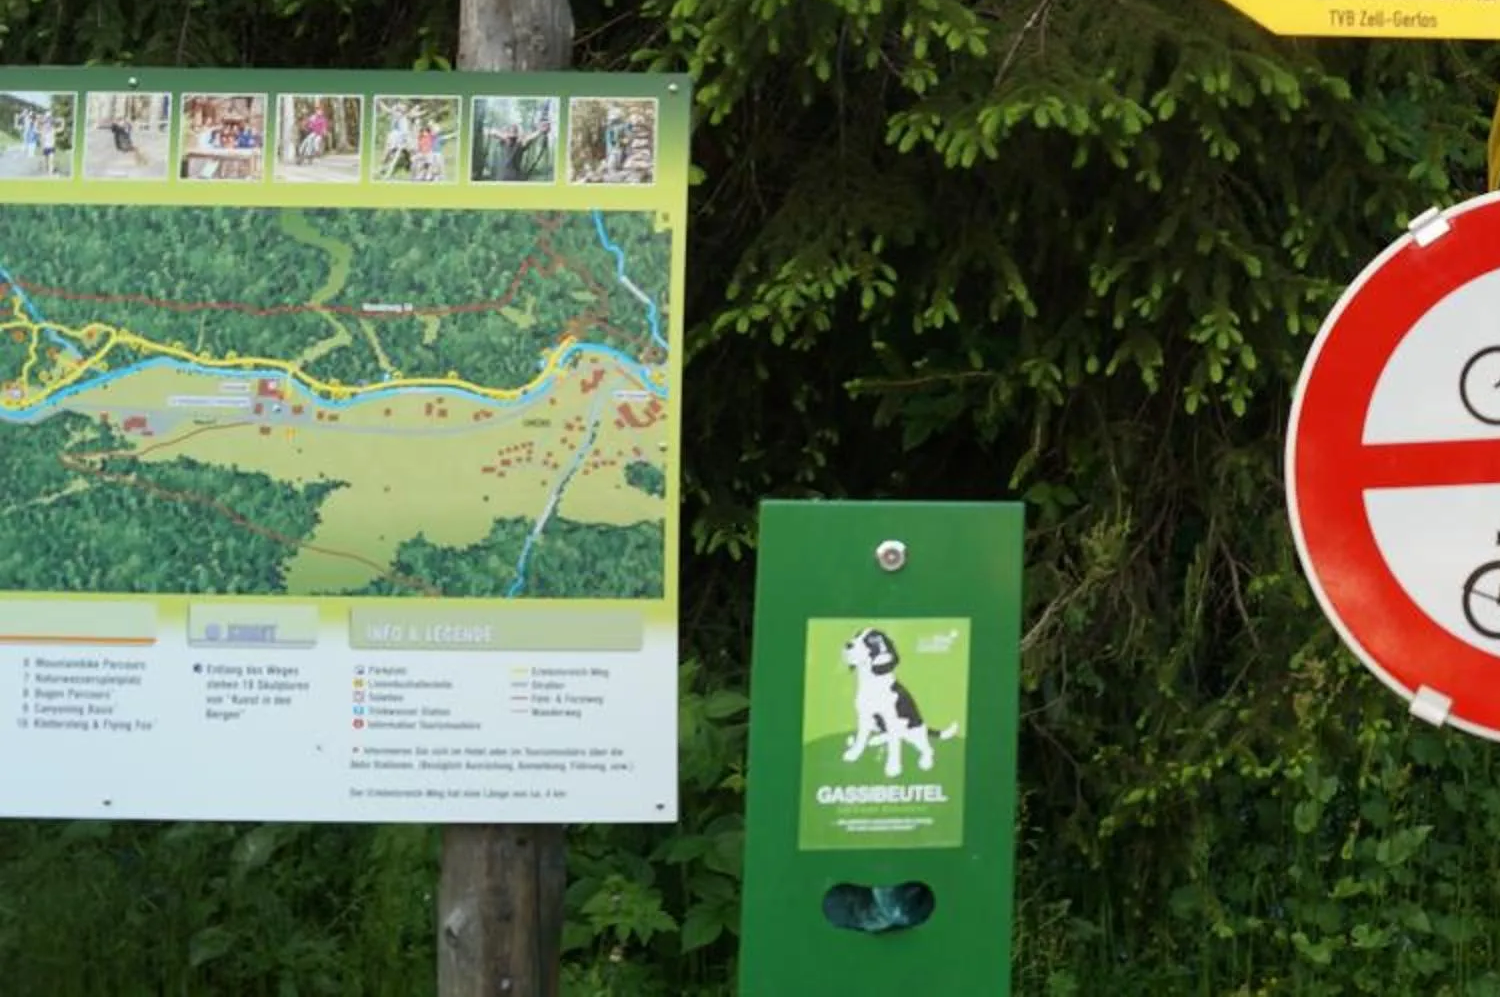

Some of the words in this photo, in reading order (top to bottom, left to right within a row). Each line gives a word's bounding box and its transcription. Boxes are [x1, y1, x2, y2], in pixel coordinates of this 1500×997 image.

[1328, 9, 1355, 27] TVB
[1359, 9, 1438, 28] Zell-Gerlos
[816, 784, 946, 804] GASSIBEUTEL
